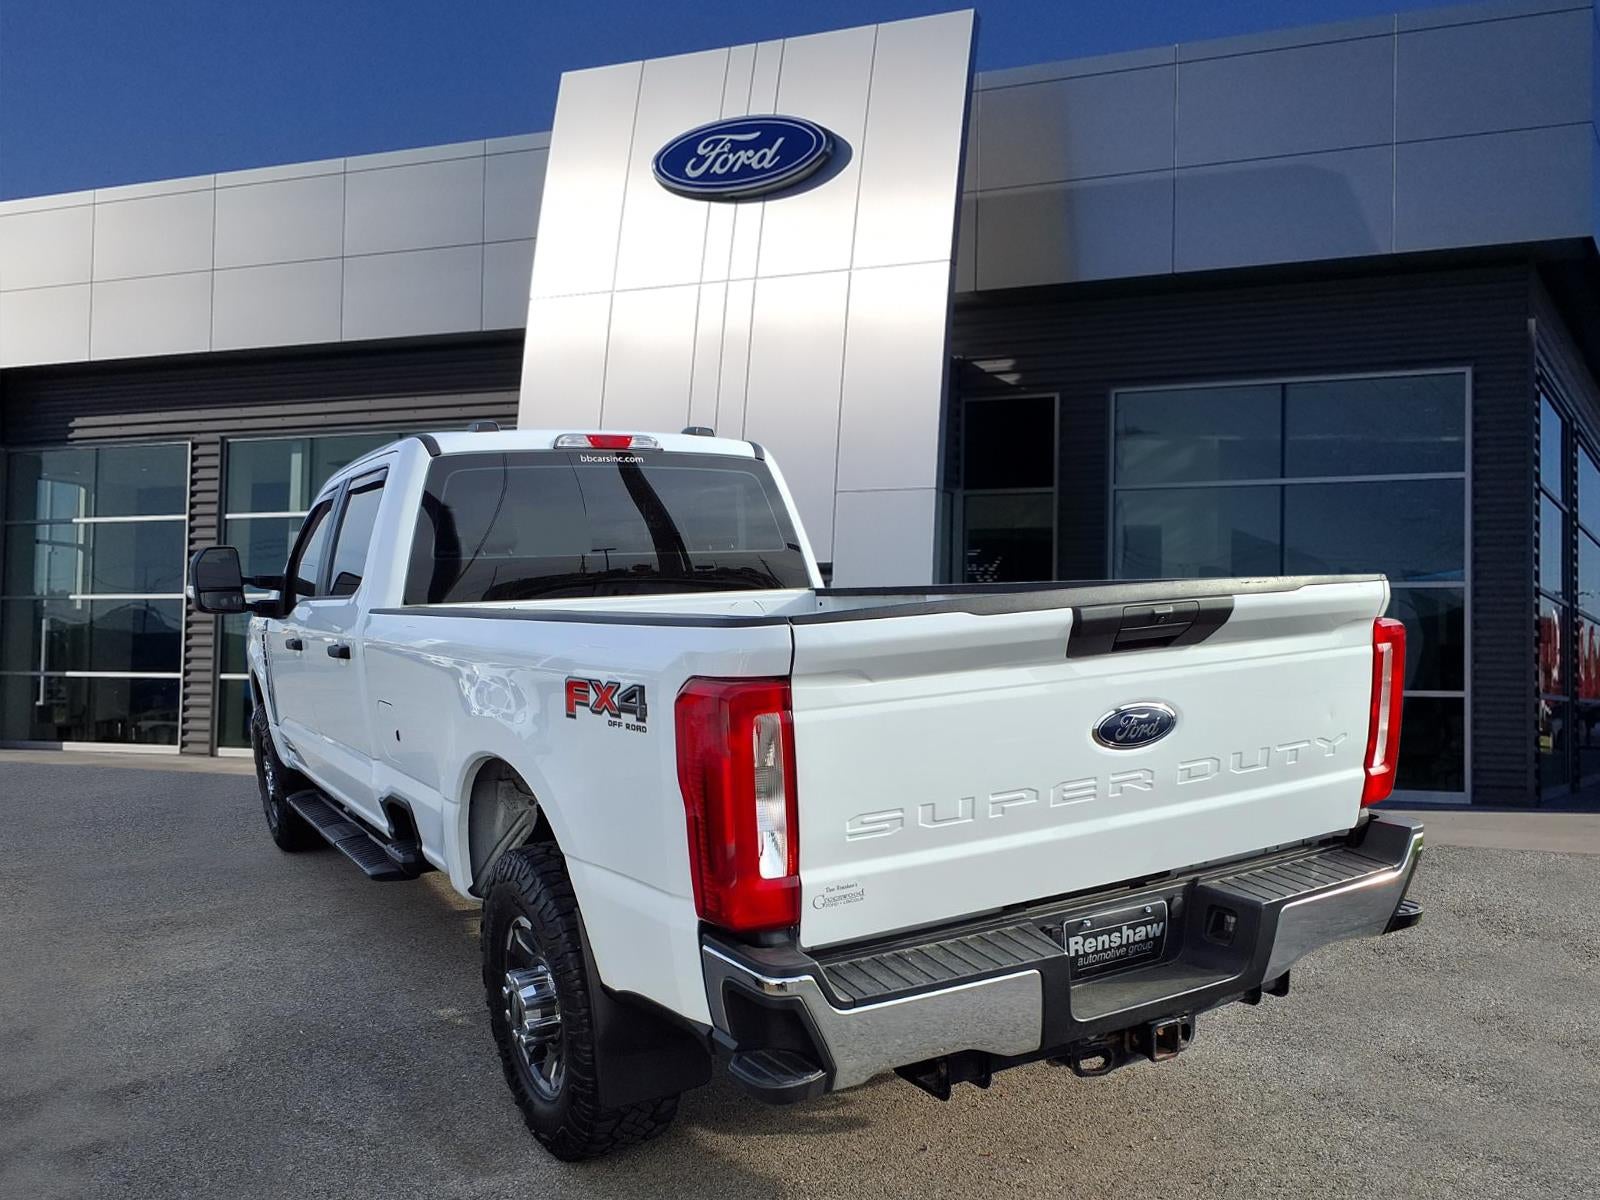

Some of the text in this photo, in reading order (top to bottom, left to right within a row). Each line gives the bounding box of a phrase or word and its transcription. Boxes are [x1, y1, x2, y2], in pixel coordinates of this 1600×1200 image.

[685, 131, 784, 178] Ford
[580, 455, 644, 463] bbcarsinc.com
[565, 676, 647, 723] FX4
[607, 719, 648, 733] OFF ROAD
[1115, 712, 1161, 741] Ford
[845, 732, 1348, 842] SUPER DUTY
[1068, 922, 1164, 957] Renshaw
[1077, 940, 1154, 966] automotive group
